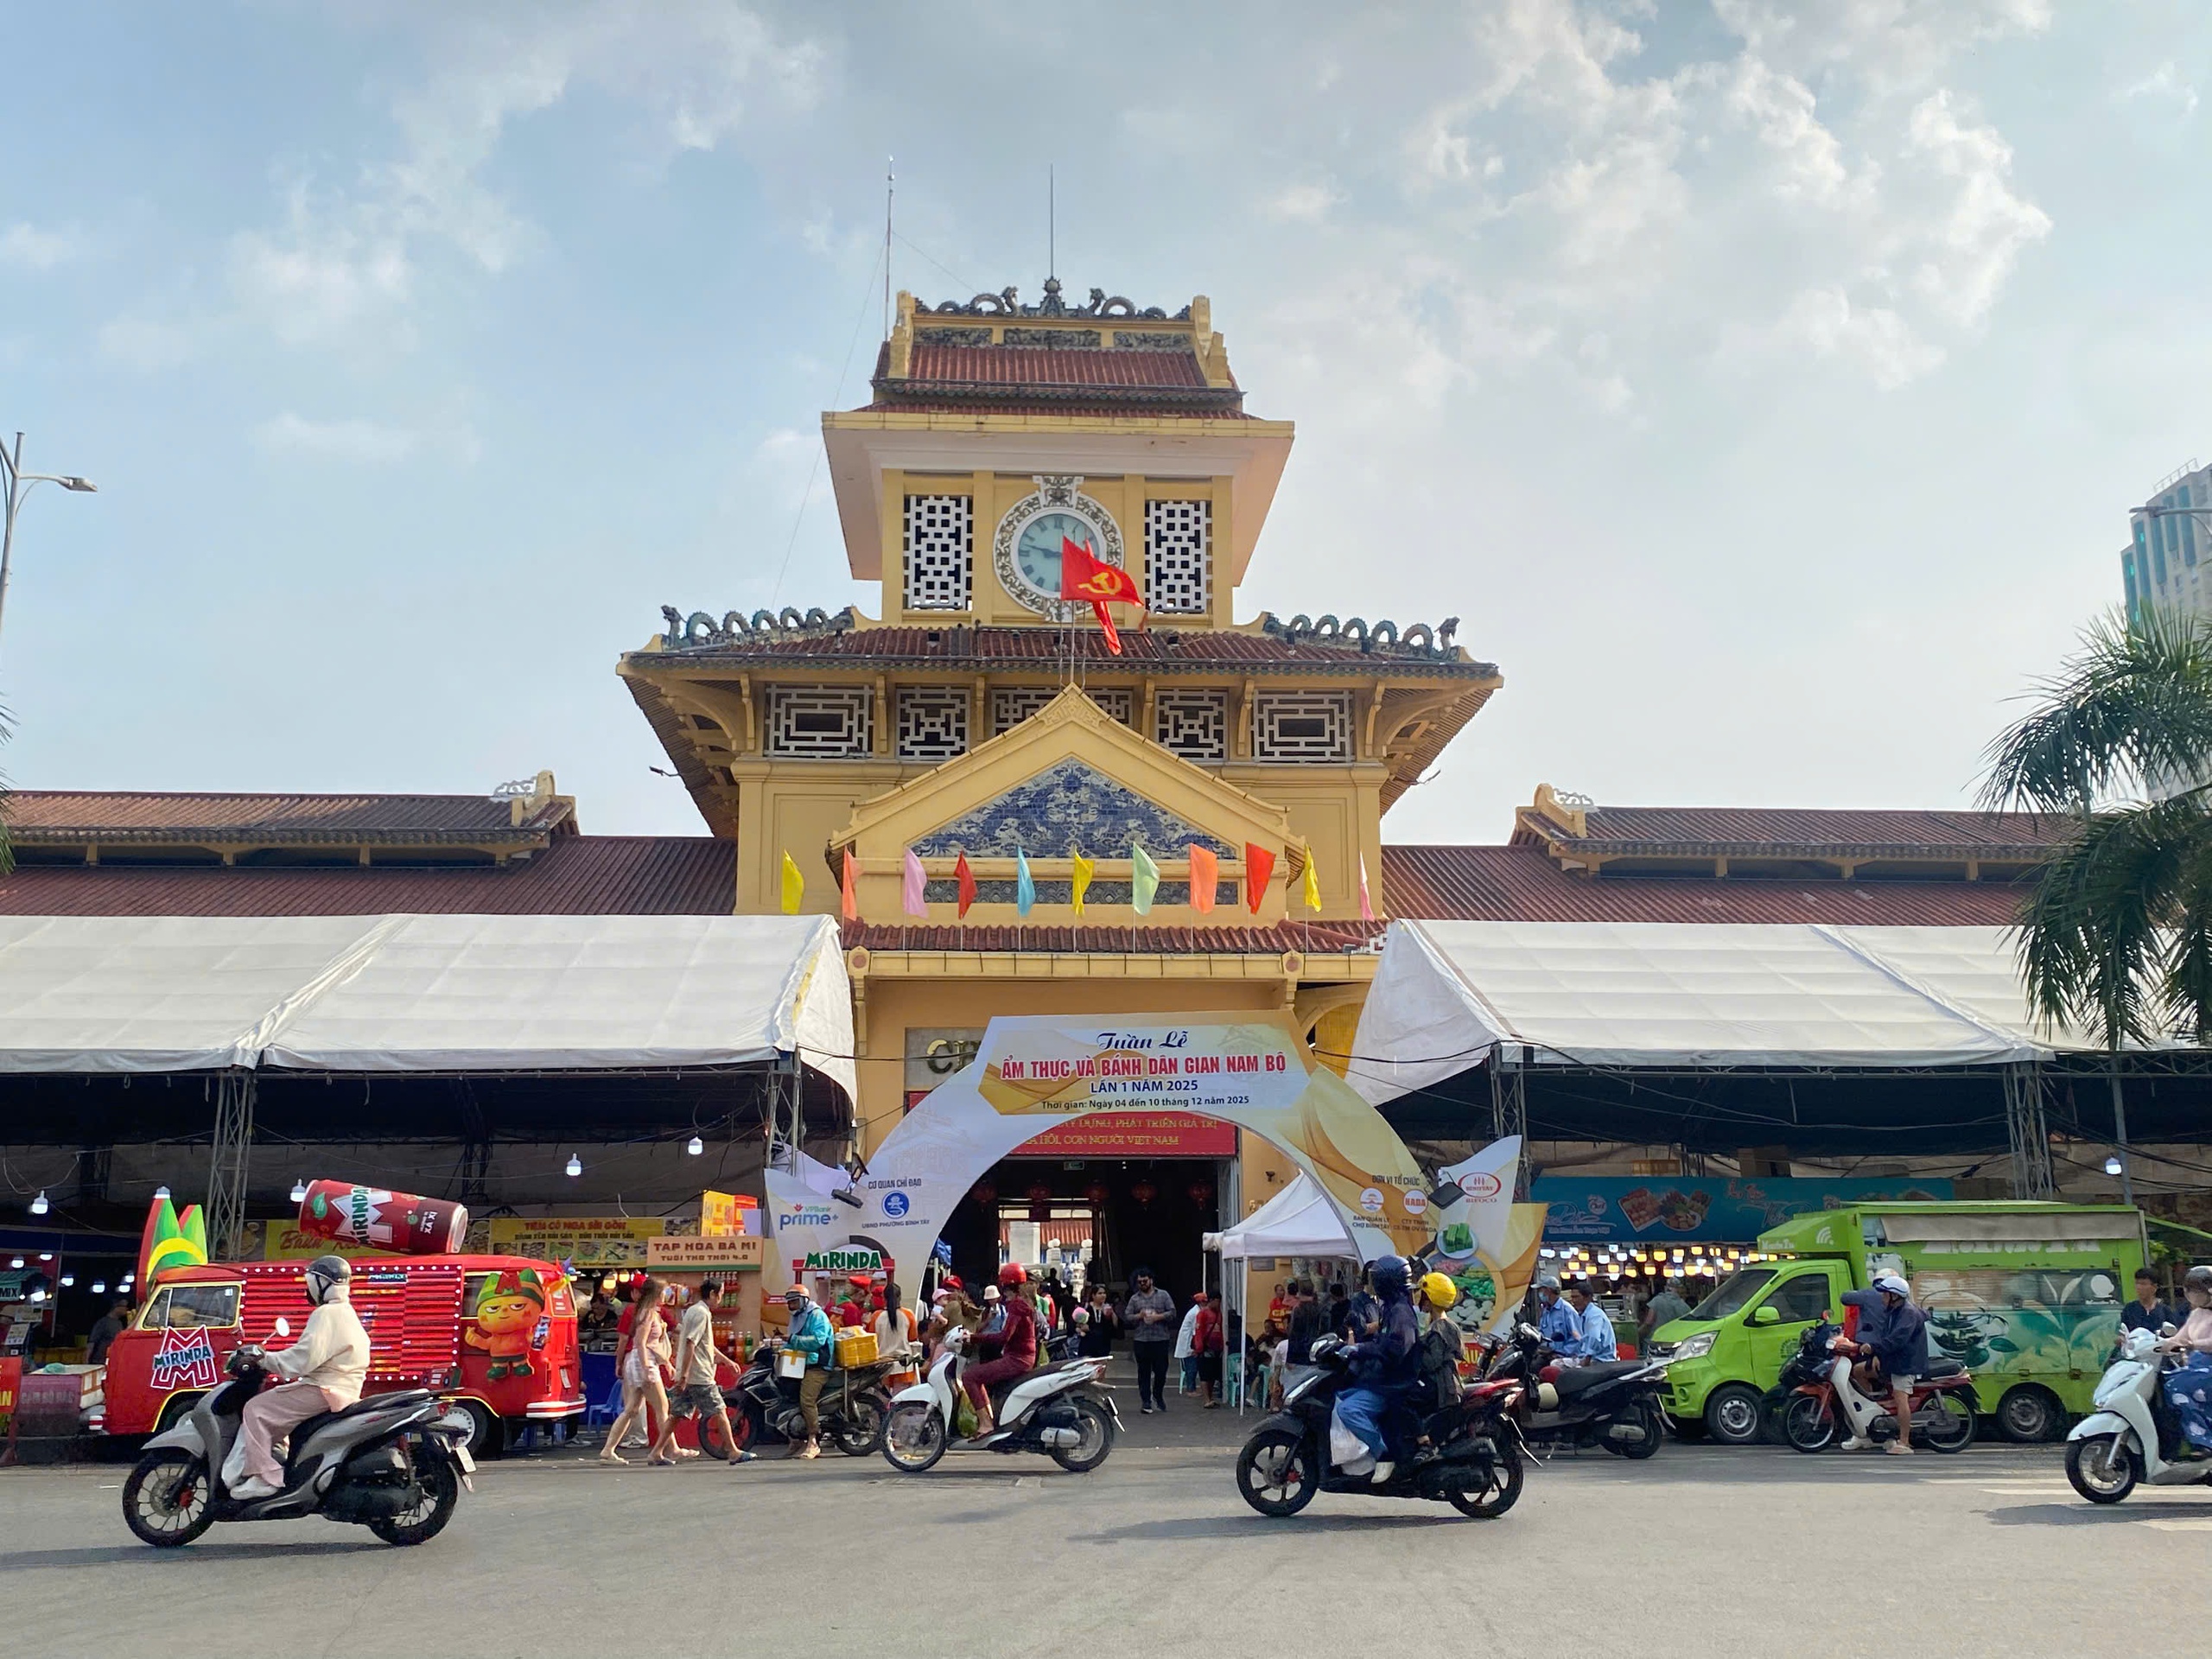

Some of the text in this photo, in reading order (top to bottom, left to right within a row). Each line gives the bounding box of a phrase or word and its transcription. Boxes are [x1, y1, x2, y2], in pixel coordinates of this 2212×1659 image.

[1159, 1031, 1189, 1048] Lễ
[1001, 1052, 1286, 1080] ẨM THỰC VÀ BÁNH DÂN GIAN NAM BỘ
[1122, 1082, 1128, 1092] 1
[1132, 1078, 1163, 1092] NĂM
[1166, 1080, 1198, 1091] 2025
[1064, 1101, 1087, 1110] gian:
[1089, 1099, 1113, 1109] Ngày
[1115, 1099, 1127, 1108] 04
[1128, 1097, 1147, 1107] đến
[1148, 1098, 1160, 1107] 10
[1162, 1096, 1189, 1107] tháng
[1205, 1096, 1225, 1105] năm
[1227, 1096, 1249, 1104] 2025
